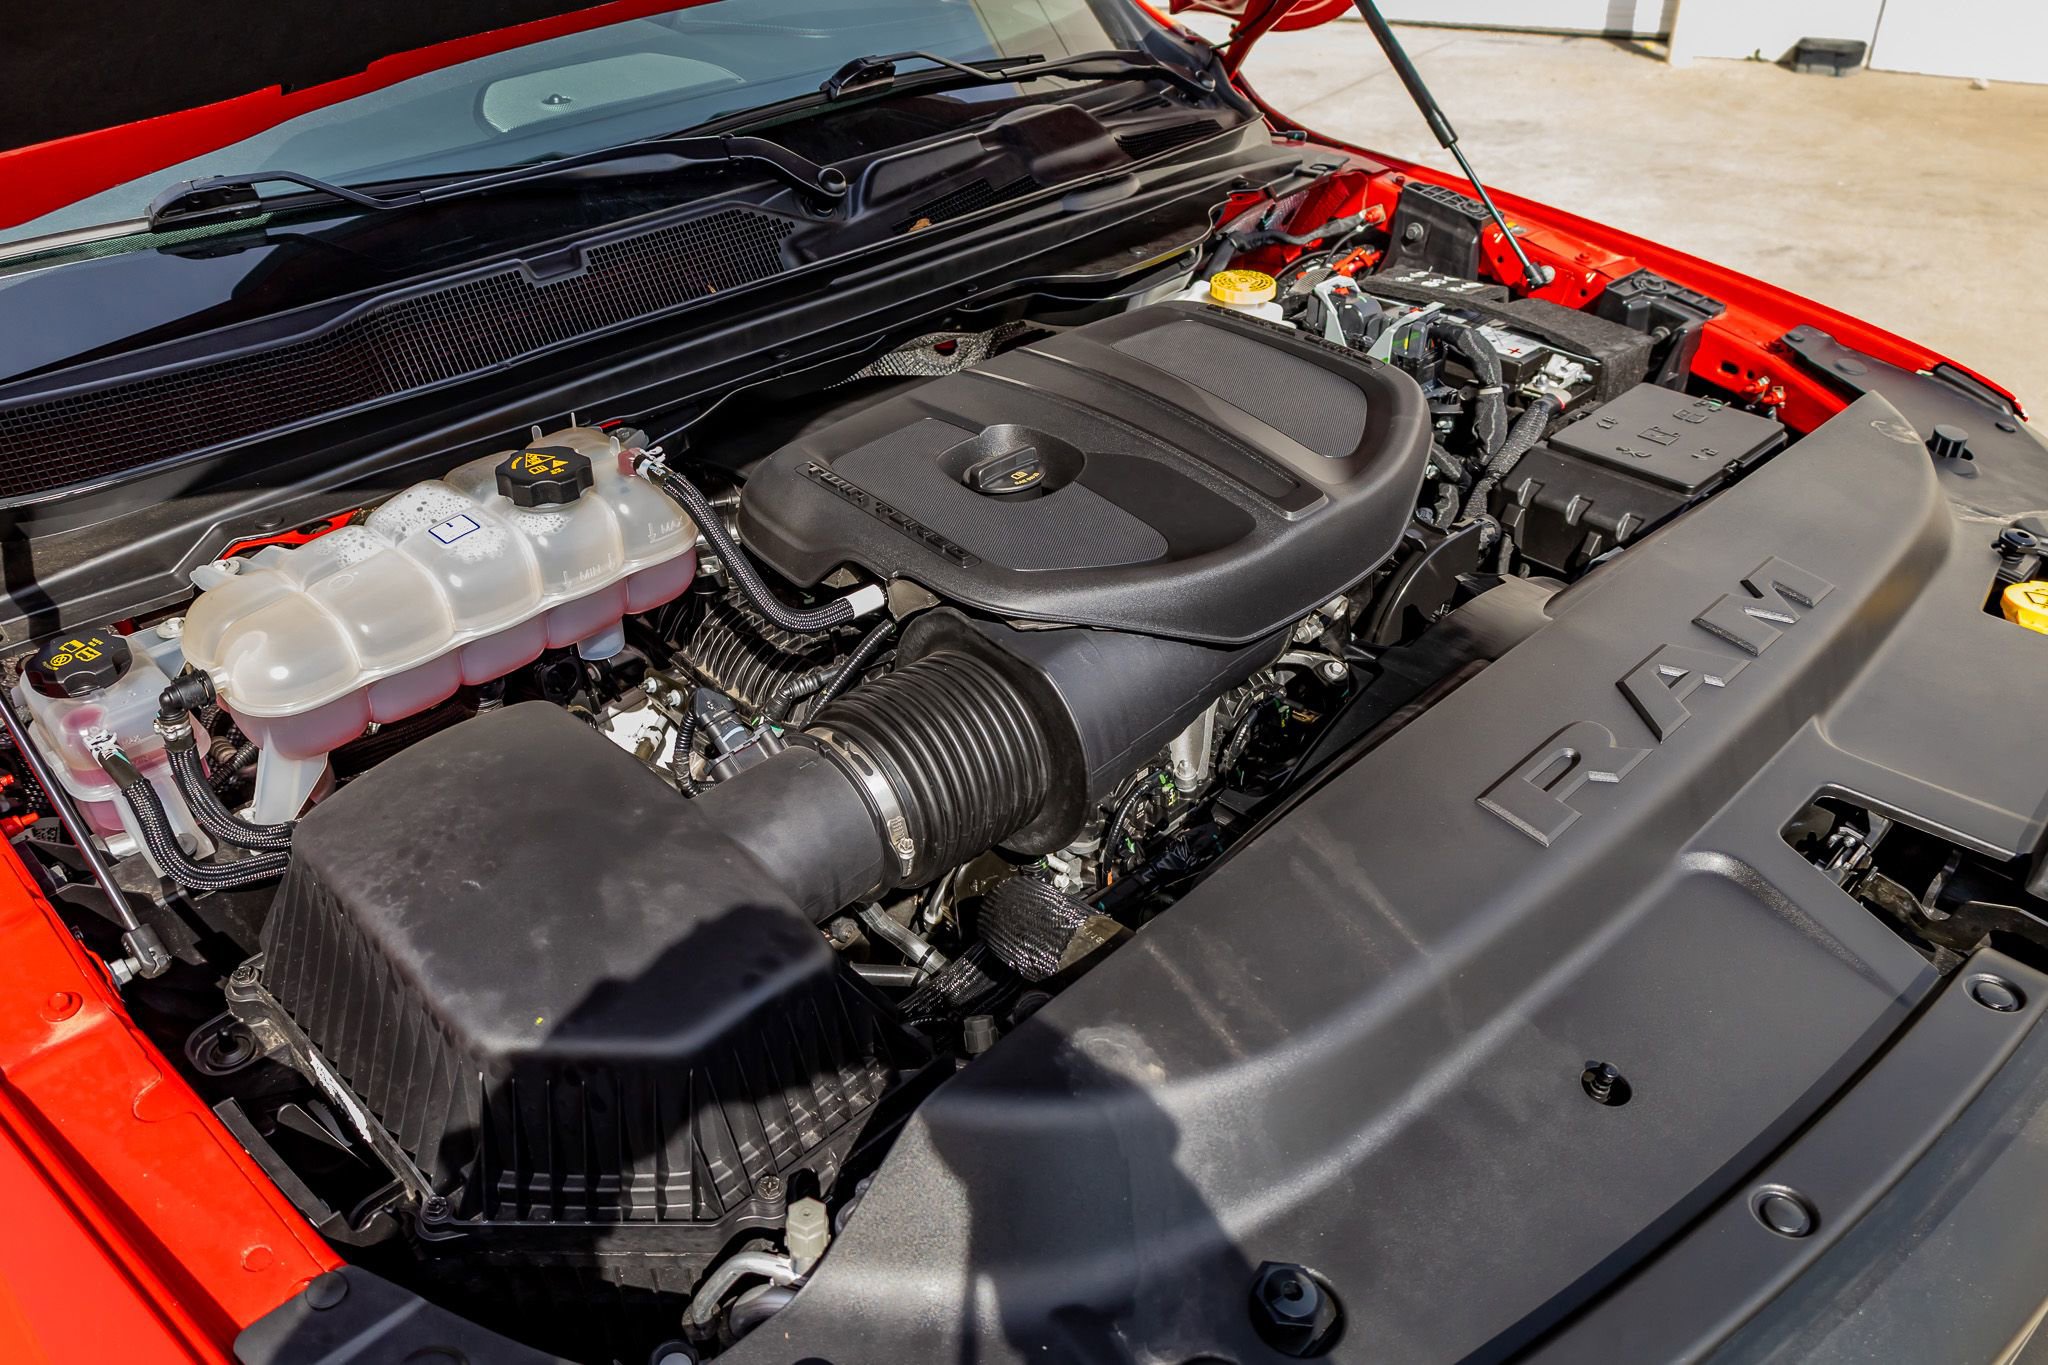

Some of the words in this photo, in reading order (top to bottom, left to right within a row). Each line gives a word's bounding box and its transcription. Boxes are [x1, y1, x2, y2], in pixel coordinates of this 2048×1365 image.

[807, 461, 869, 505] TWIN
[875, 501, 970, 566] TURBO
[1475, 556, 1836, 848] RAM
